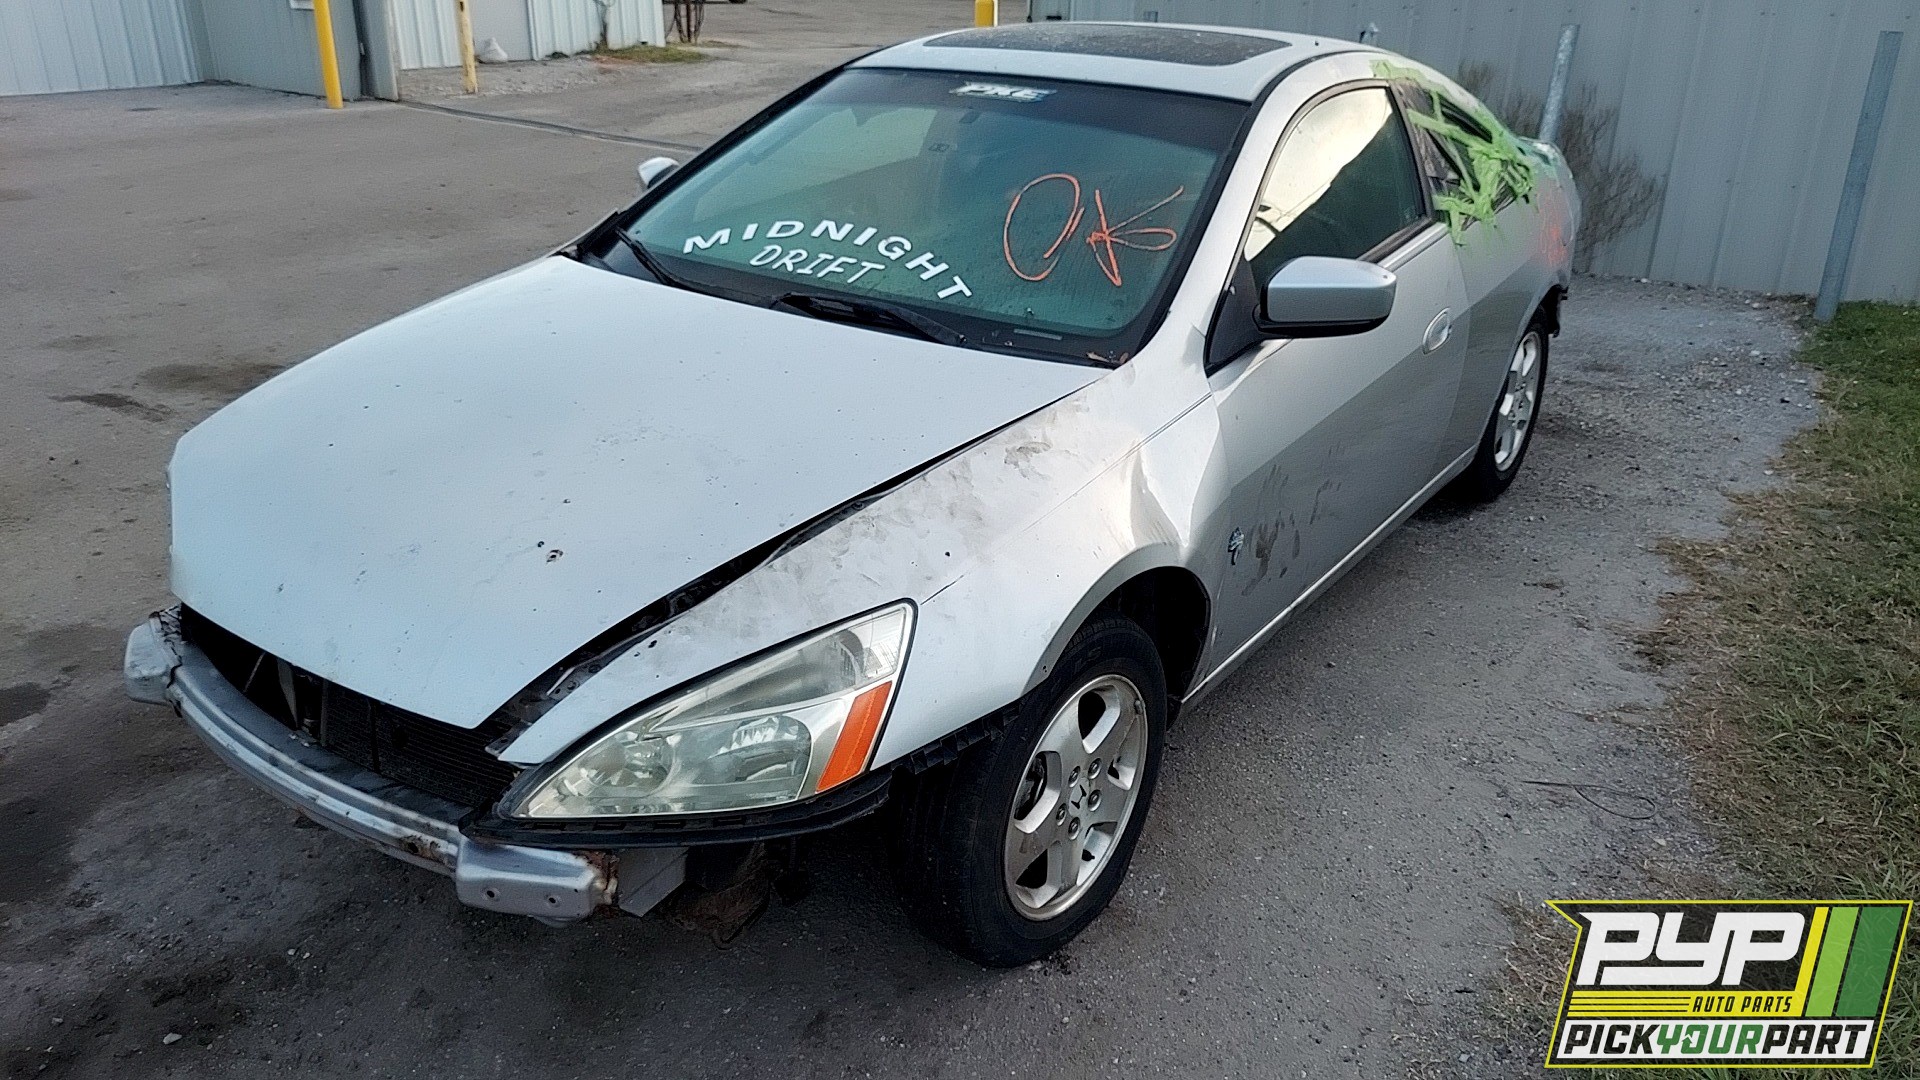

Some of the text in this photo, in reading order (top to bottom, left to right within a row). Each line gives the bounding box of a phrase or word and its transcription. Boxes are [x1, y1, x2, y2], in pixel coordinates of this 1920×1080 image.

[683, 219, 973, 299] MIDNIGHT
[749, 244, 886, 284] DRIFT
[1003, 173, 1184, 287] OK
